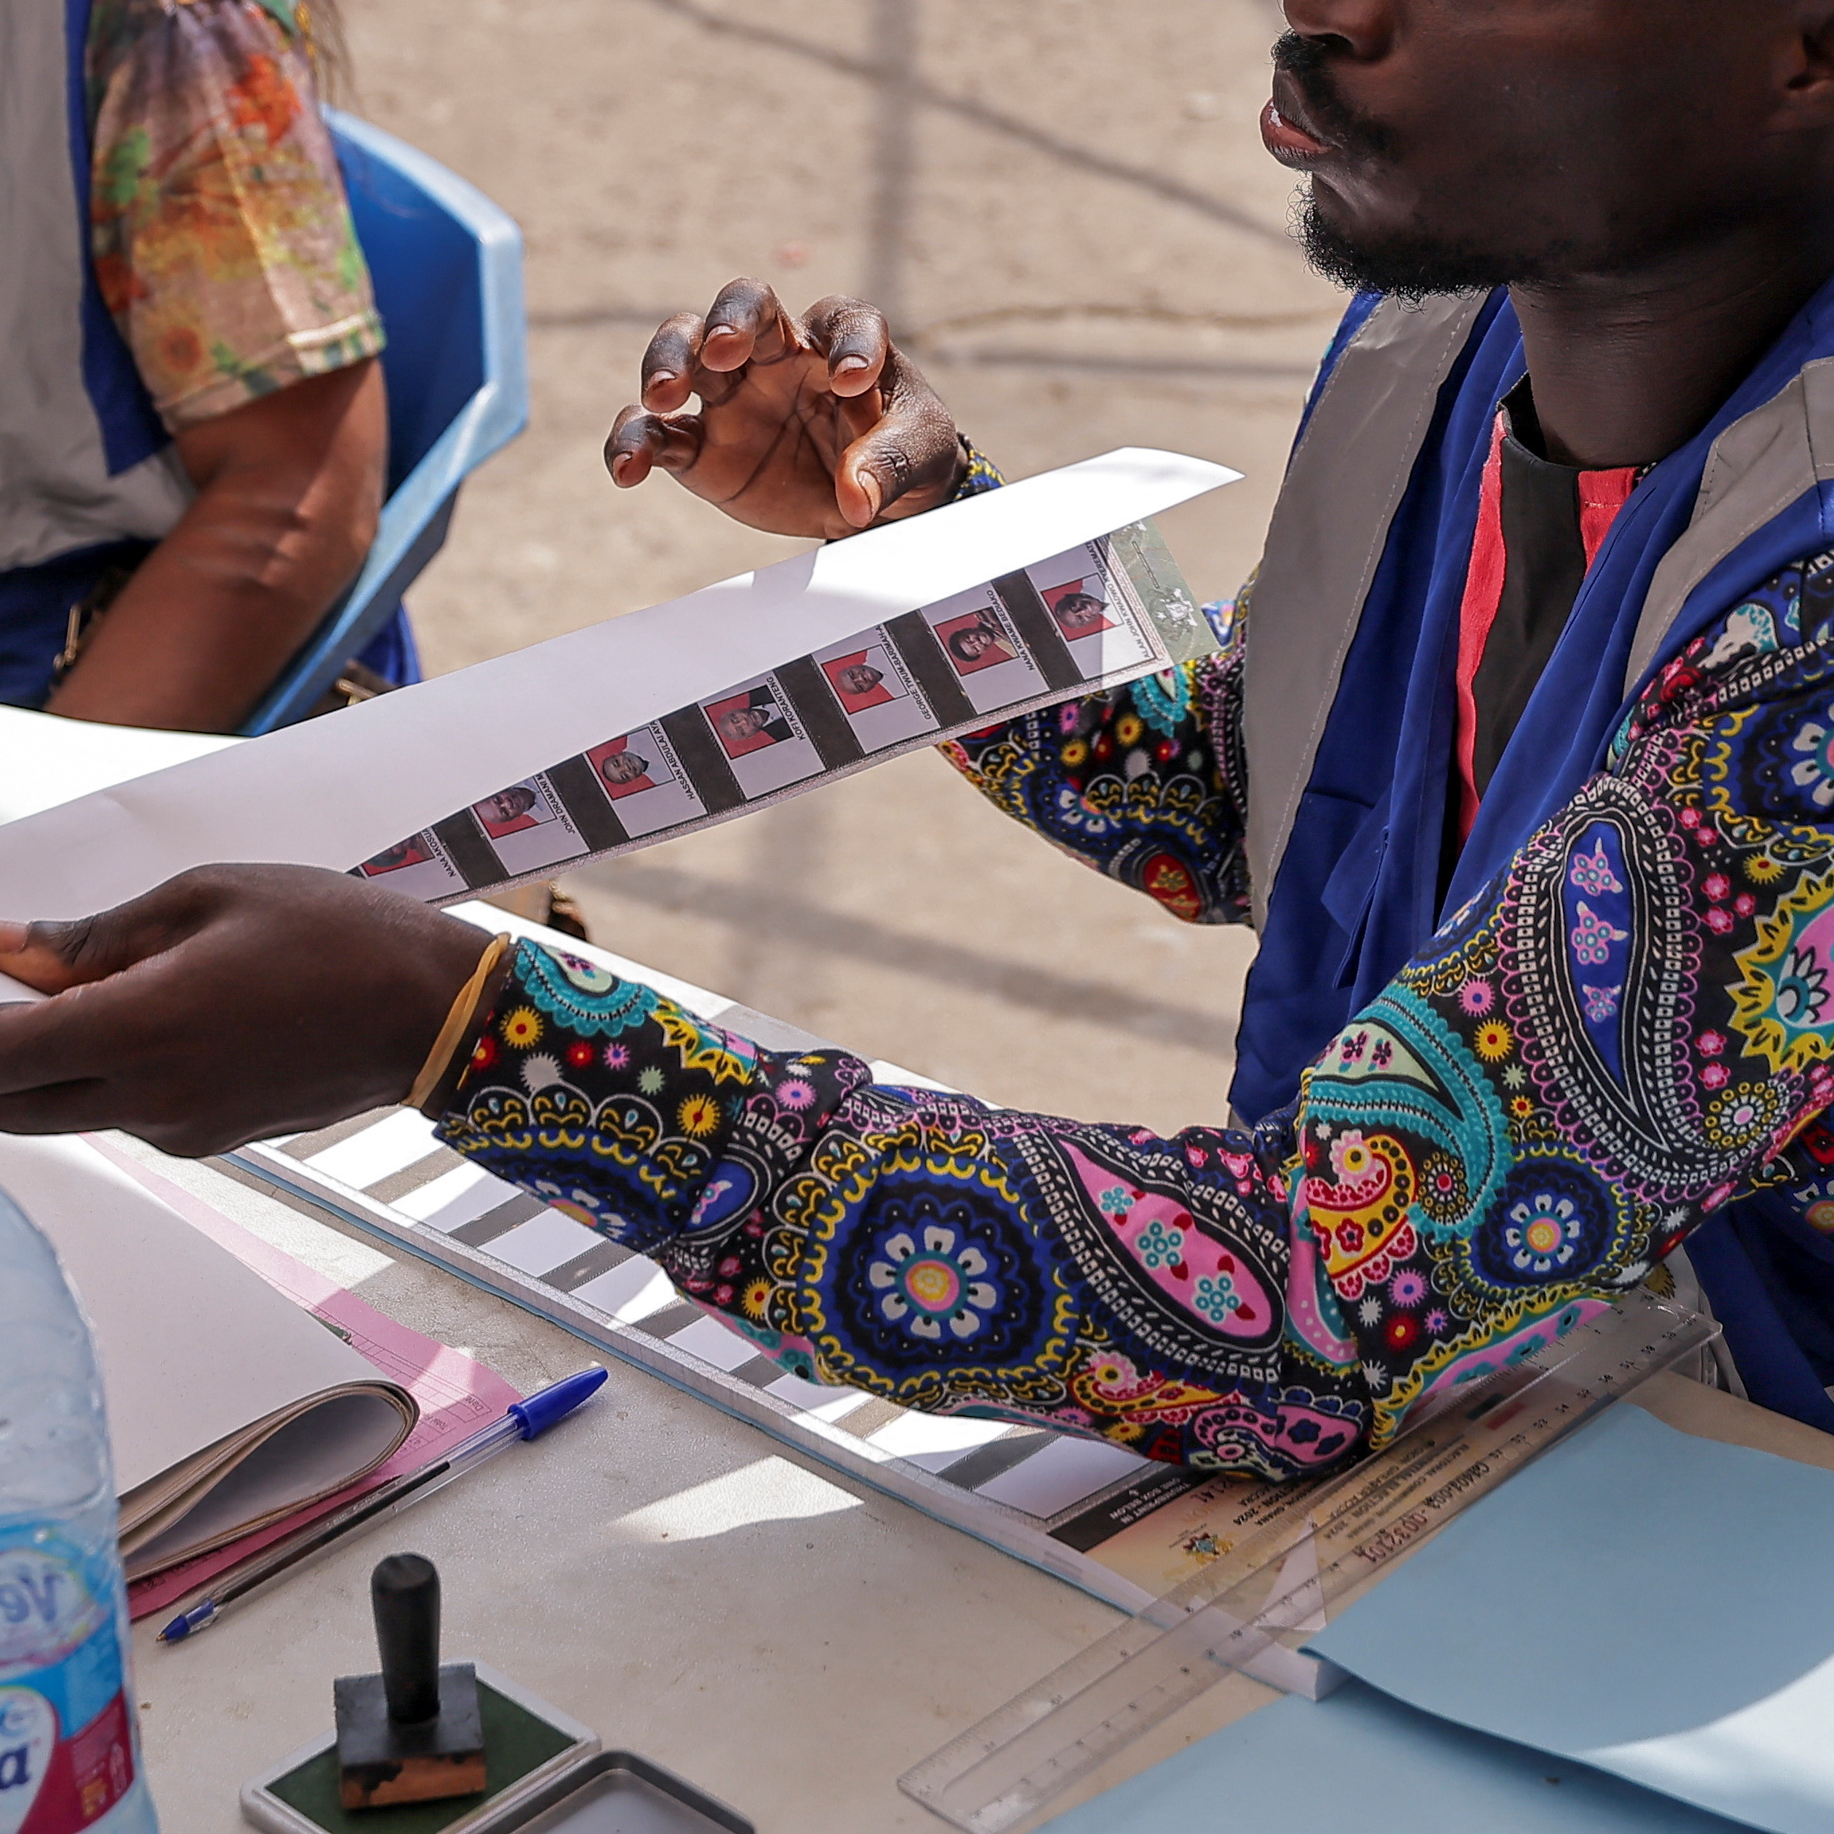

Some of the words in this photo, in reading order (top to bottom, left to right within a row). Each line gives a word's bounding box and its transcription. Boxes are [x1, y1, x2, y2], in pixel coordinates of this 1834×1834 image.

[986, 589, 1011, 633] BEDIAKO
[1124, 617, 1139, 638] JOHN
[1005, 628, 1027, 654] KWAME
[876, 624, 916, 692] TWUM-BARIMAH-A
[1019, 651, 1035, 671] NANA
[766, 676, 796, 723] KORANTENG
[909, 688, 932, 720] GEORGE
[649, 720, 662, 735] AYA
[791, 721, 806, 741] KOFI
[657, 732, 681, 770] ABDULAI
[674, 768, 696, 801] HASSAN
[539, 778, 563, 817] DRAMANI
[558, 816, 576, 835] JOHN
[439, 857, 457, 878] NANA
[1109, 1498, 1143, 1520] BELOW
[1231, 1506, 1259, 1527] 2024
